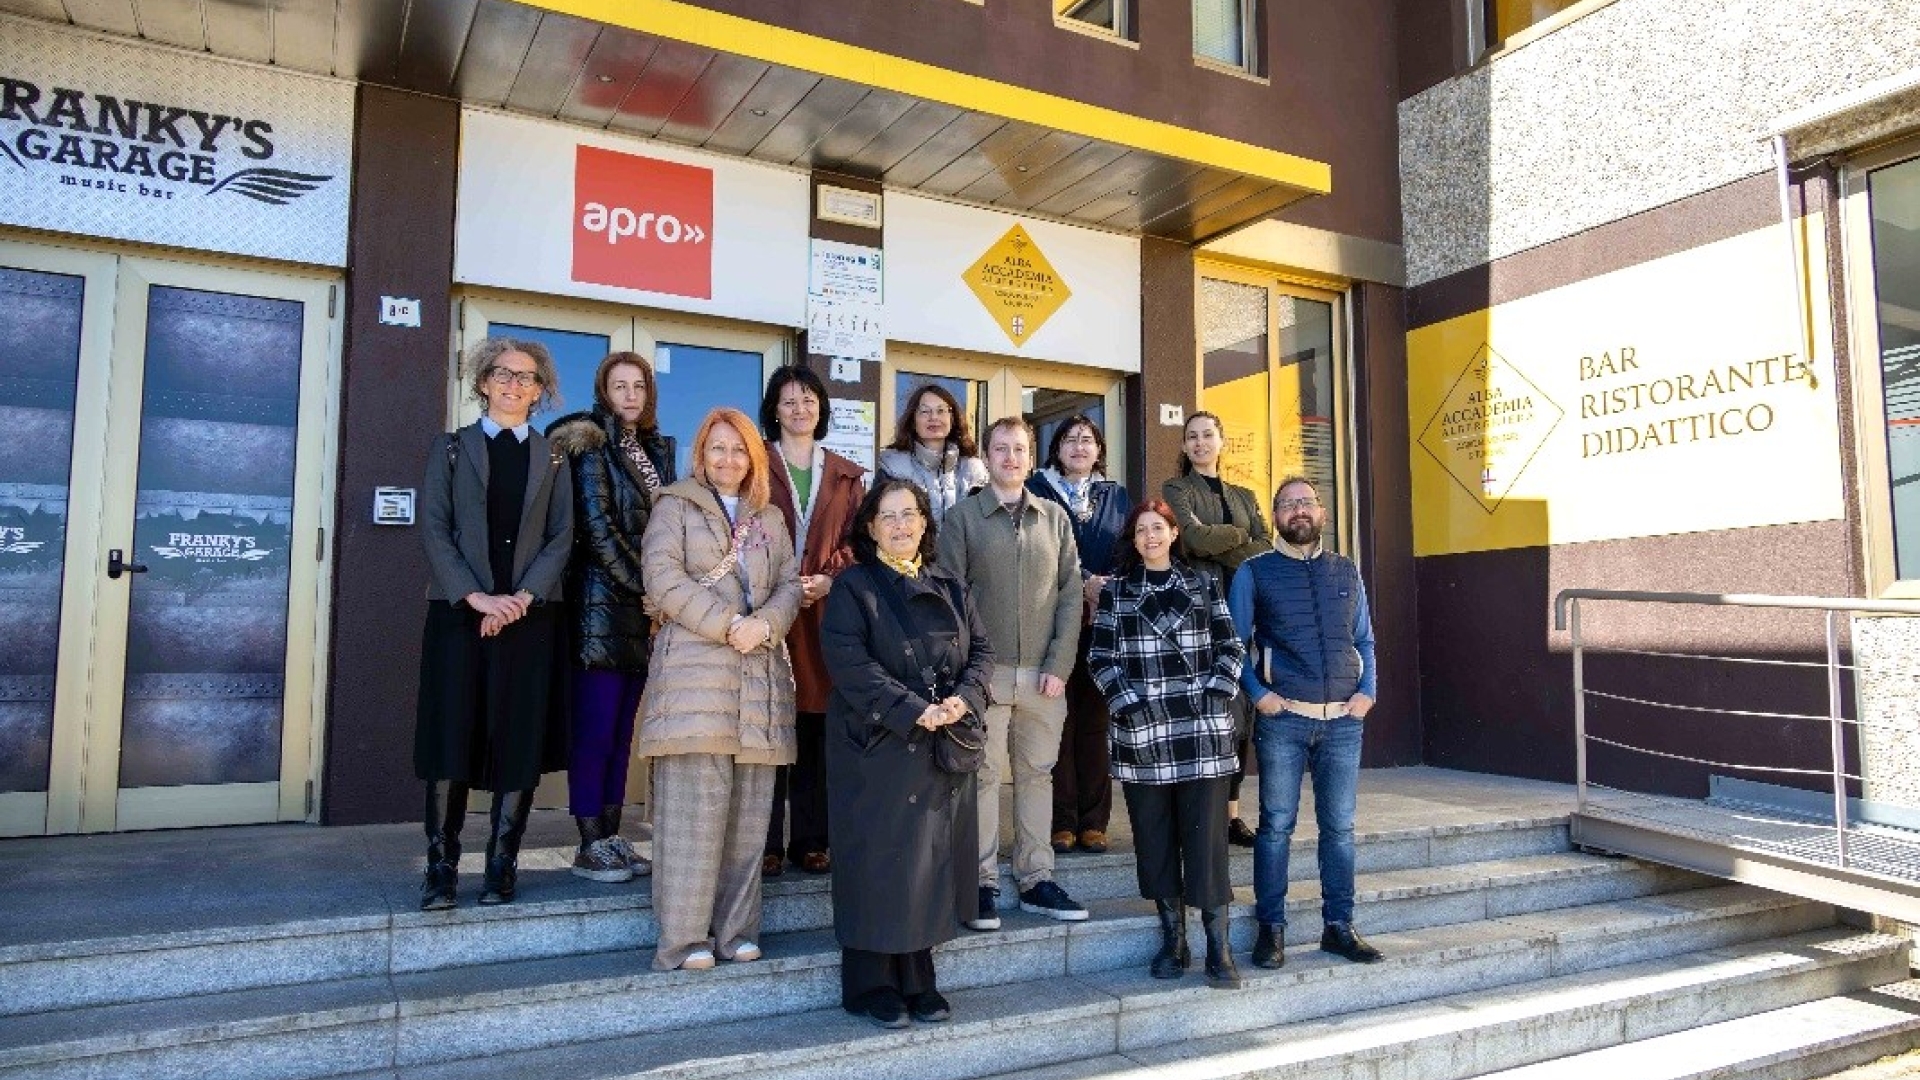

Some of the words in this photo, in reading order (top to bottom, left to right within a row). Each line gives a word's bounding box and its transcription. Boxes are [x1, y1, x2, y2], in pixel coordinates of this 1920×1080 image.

[0, 76, 275, 160] RANKY'S
[15, 128, 217, 186] GARAGE
[59, 173, 127, 193] music
[139, 183, 175, 200] bar
[982, 263, 1053, 284] ACCADEMIA
[1003, 256, 1032, 268] ALBA
[1579, 346, 1640, 381] BAR
[1467, 387, 1503, 404] ALBA
[1580, 353, 1805, 419] RISTORANTE
[1442, 396, 1533, 426] ACCADEMIA
[1582, 403, 1774, 458] DIDATTICO
[168, 532, 256, 549] FRANKY'S
[184, 546, 240, 558] GARAGE
